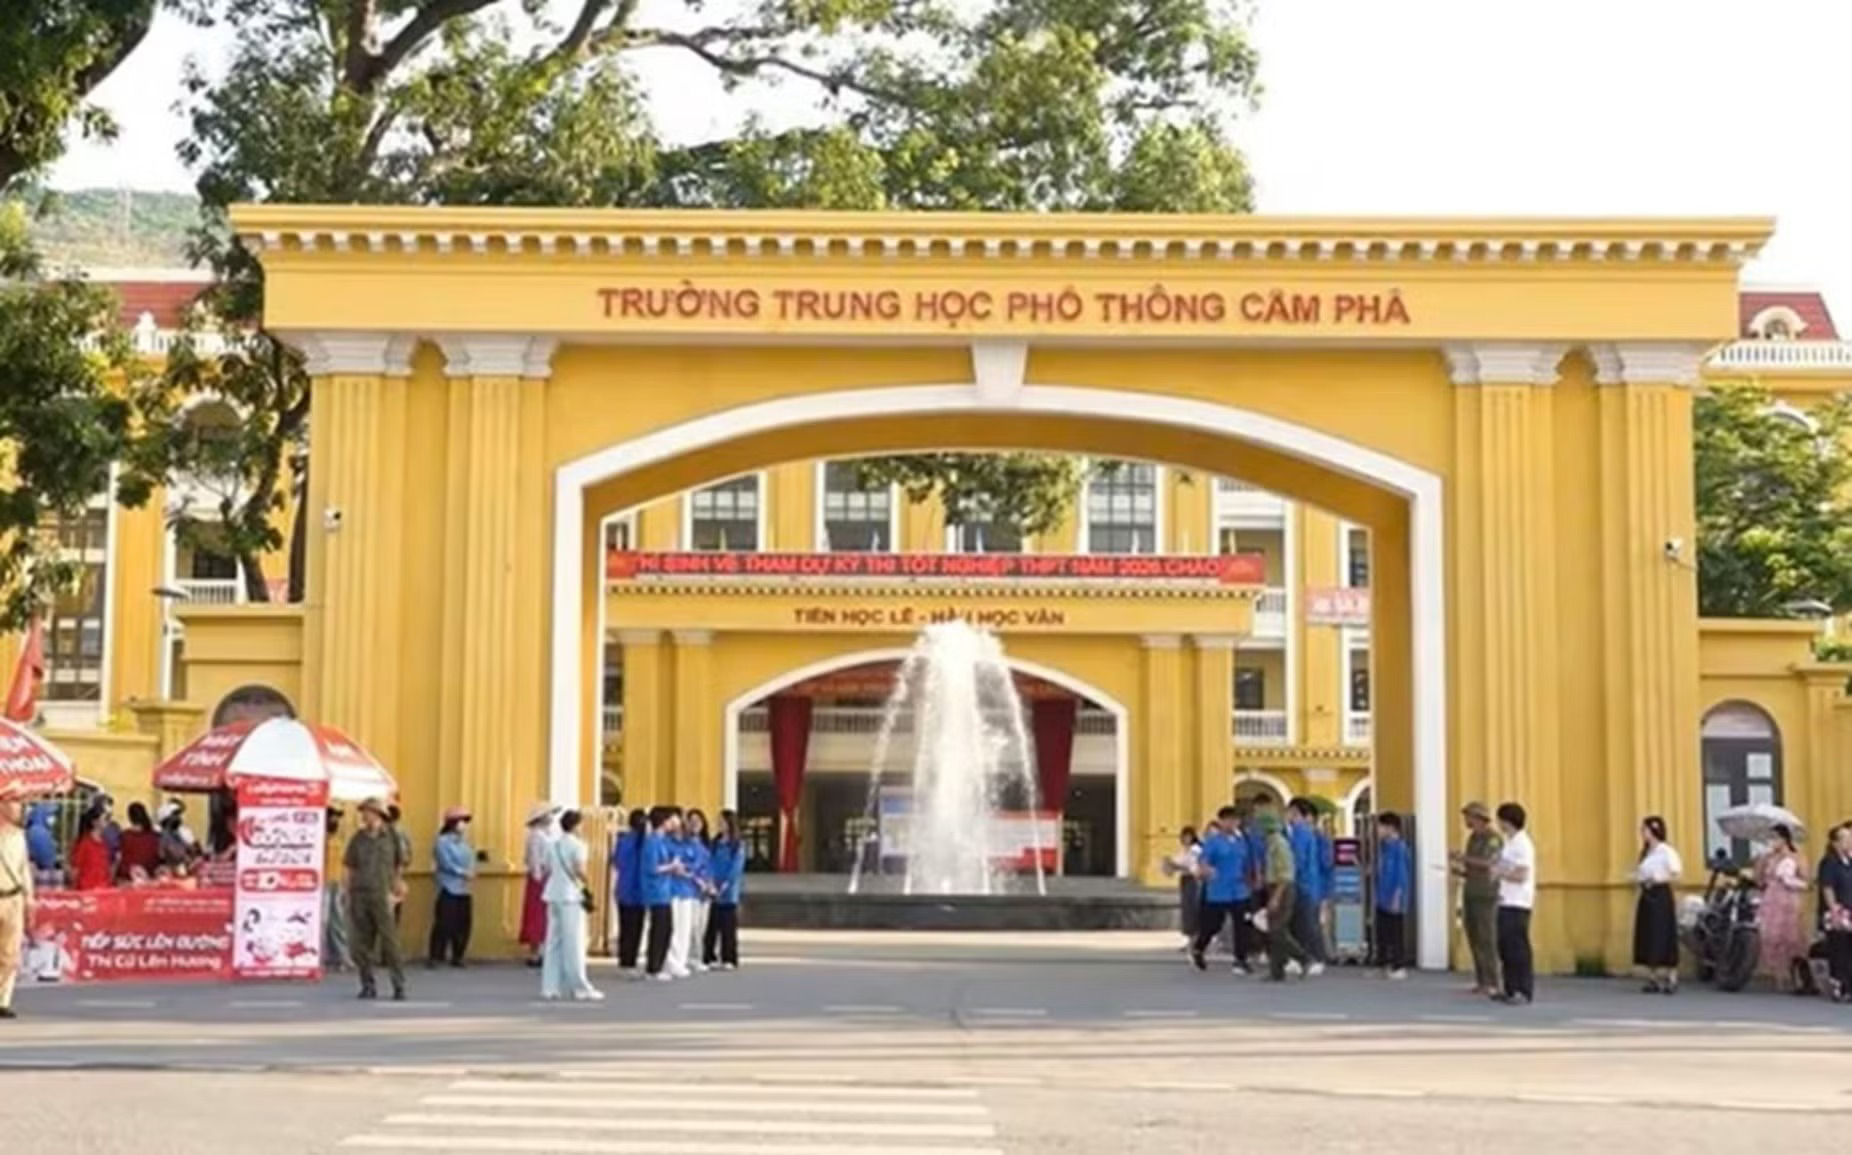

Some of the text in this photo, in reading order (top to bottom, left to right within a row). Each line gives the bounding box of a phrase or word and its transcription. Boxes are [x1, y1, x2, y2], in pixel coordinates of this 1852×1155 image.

[597, 280, 760, 319] TRƯỜNG
[773, 289, 901, 320] TRUNG
[914, 289, 993, 328] HỌC
[1095, 283, 1227, 324] THÔNG
[841, 609, 884, 626] HỌC
[977, 609, 1019, 627] HỌC
